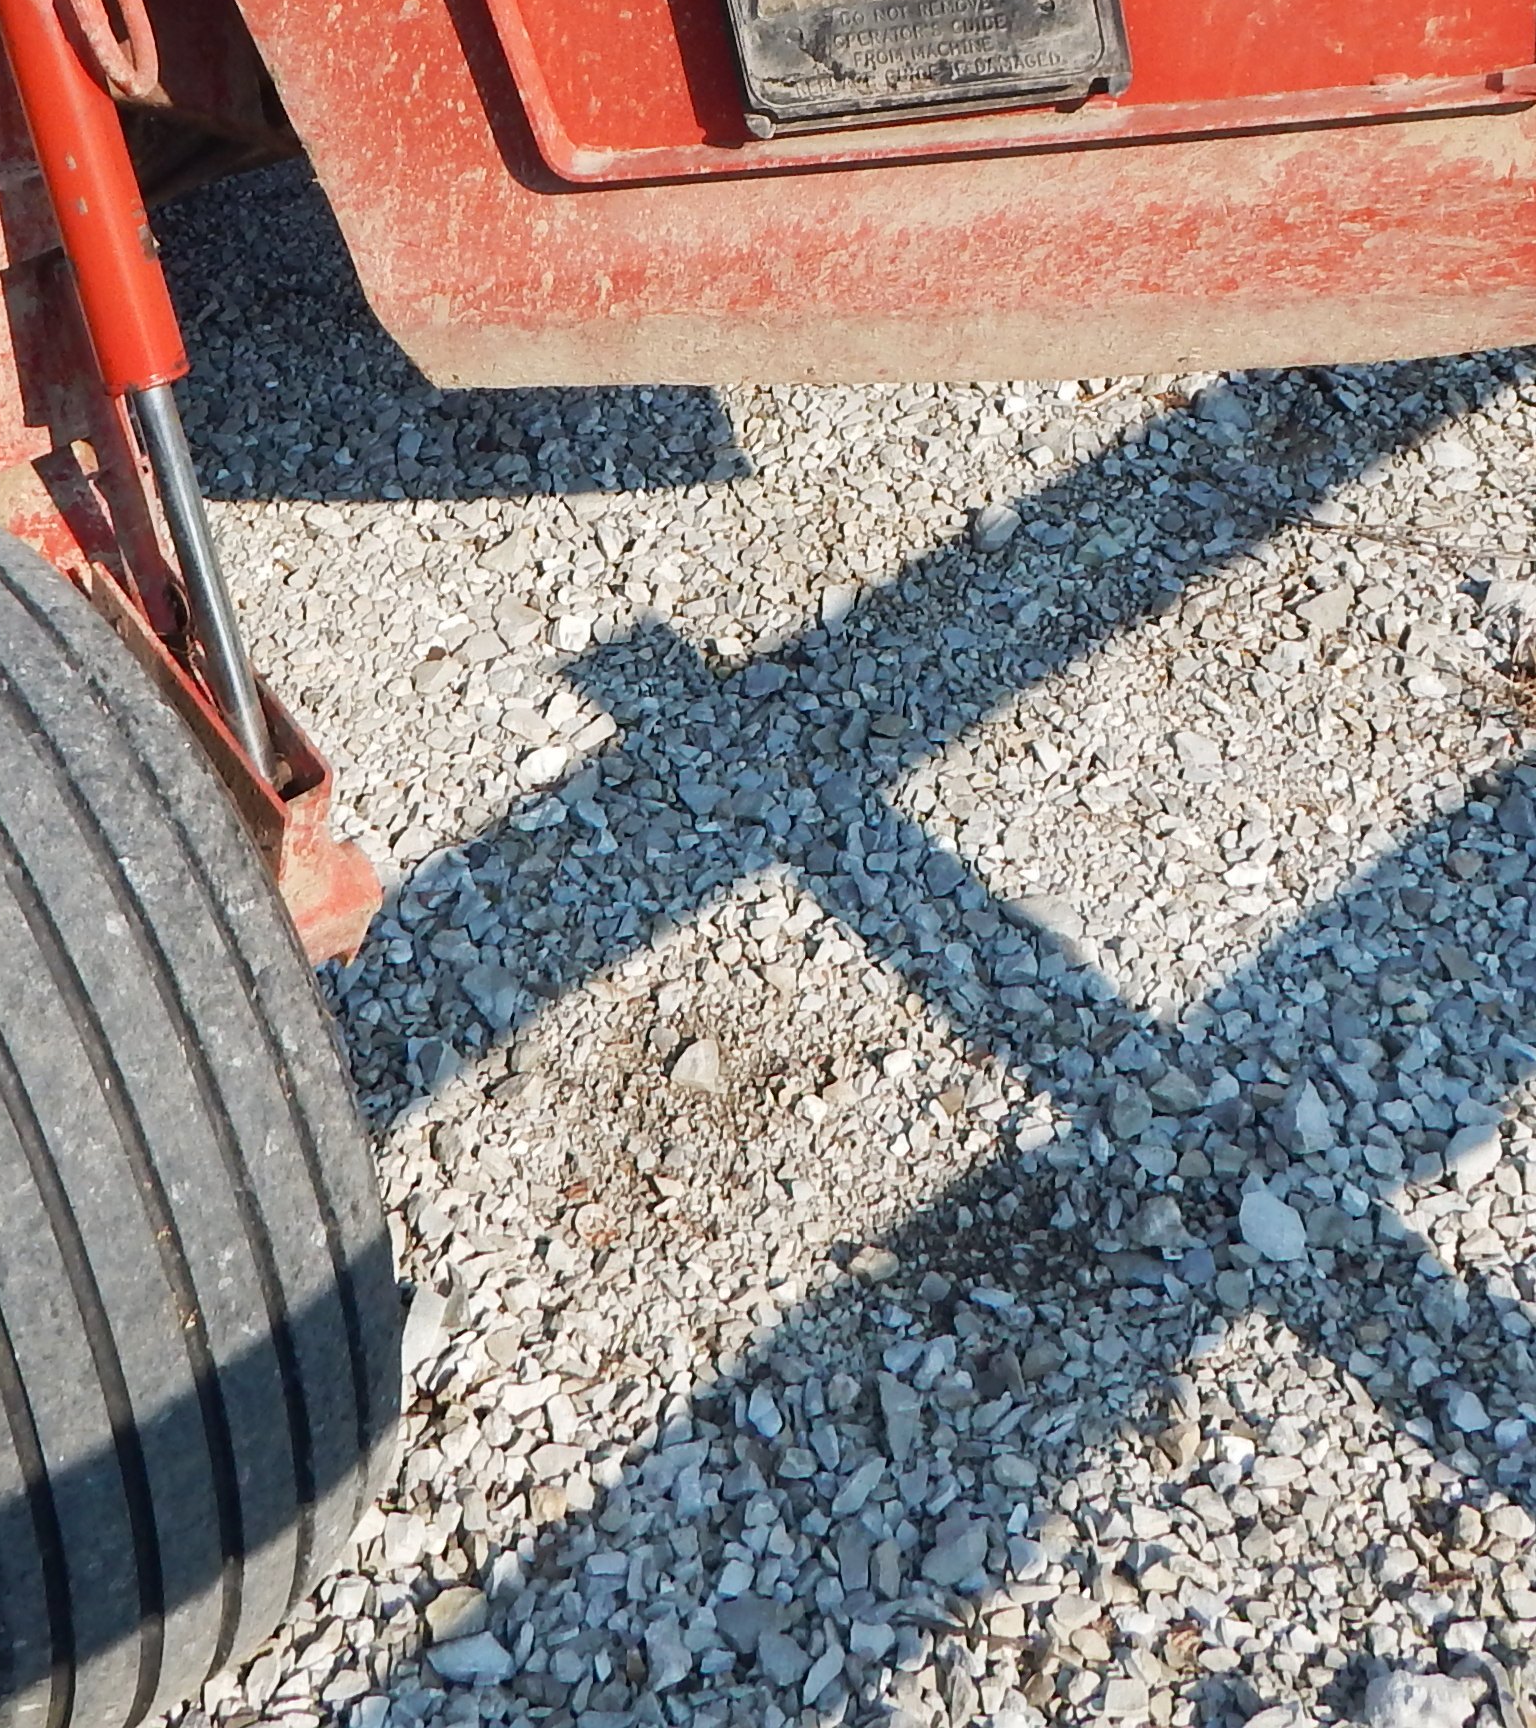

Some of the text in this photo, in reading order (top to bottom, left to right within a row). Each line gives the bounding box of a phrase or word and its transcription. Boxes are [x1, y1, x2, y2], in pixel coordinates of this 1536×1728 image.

[873, 4, 910, 23] NOT
[952, 13, 1008, 35] GUIDE
[853, 37, 993, 70] FROM MACHINE
[974, 51, 1061, 73] DAMAGED
